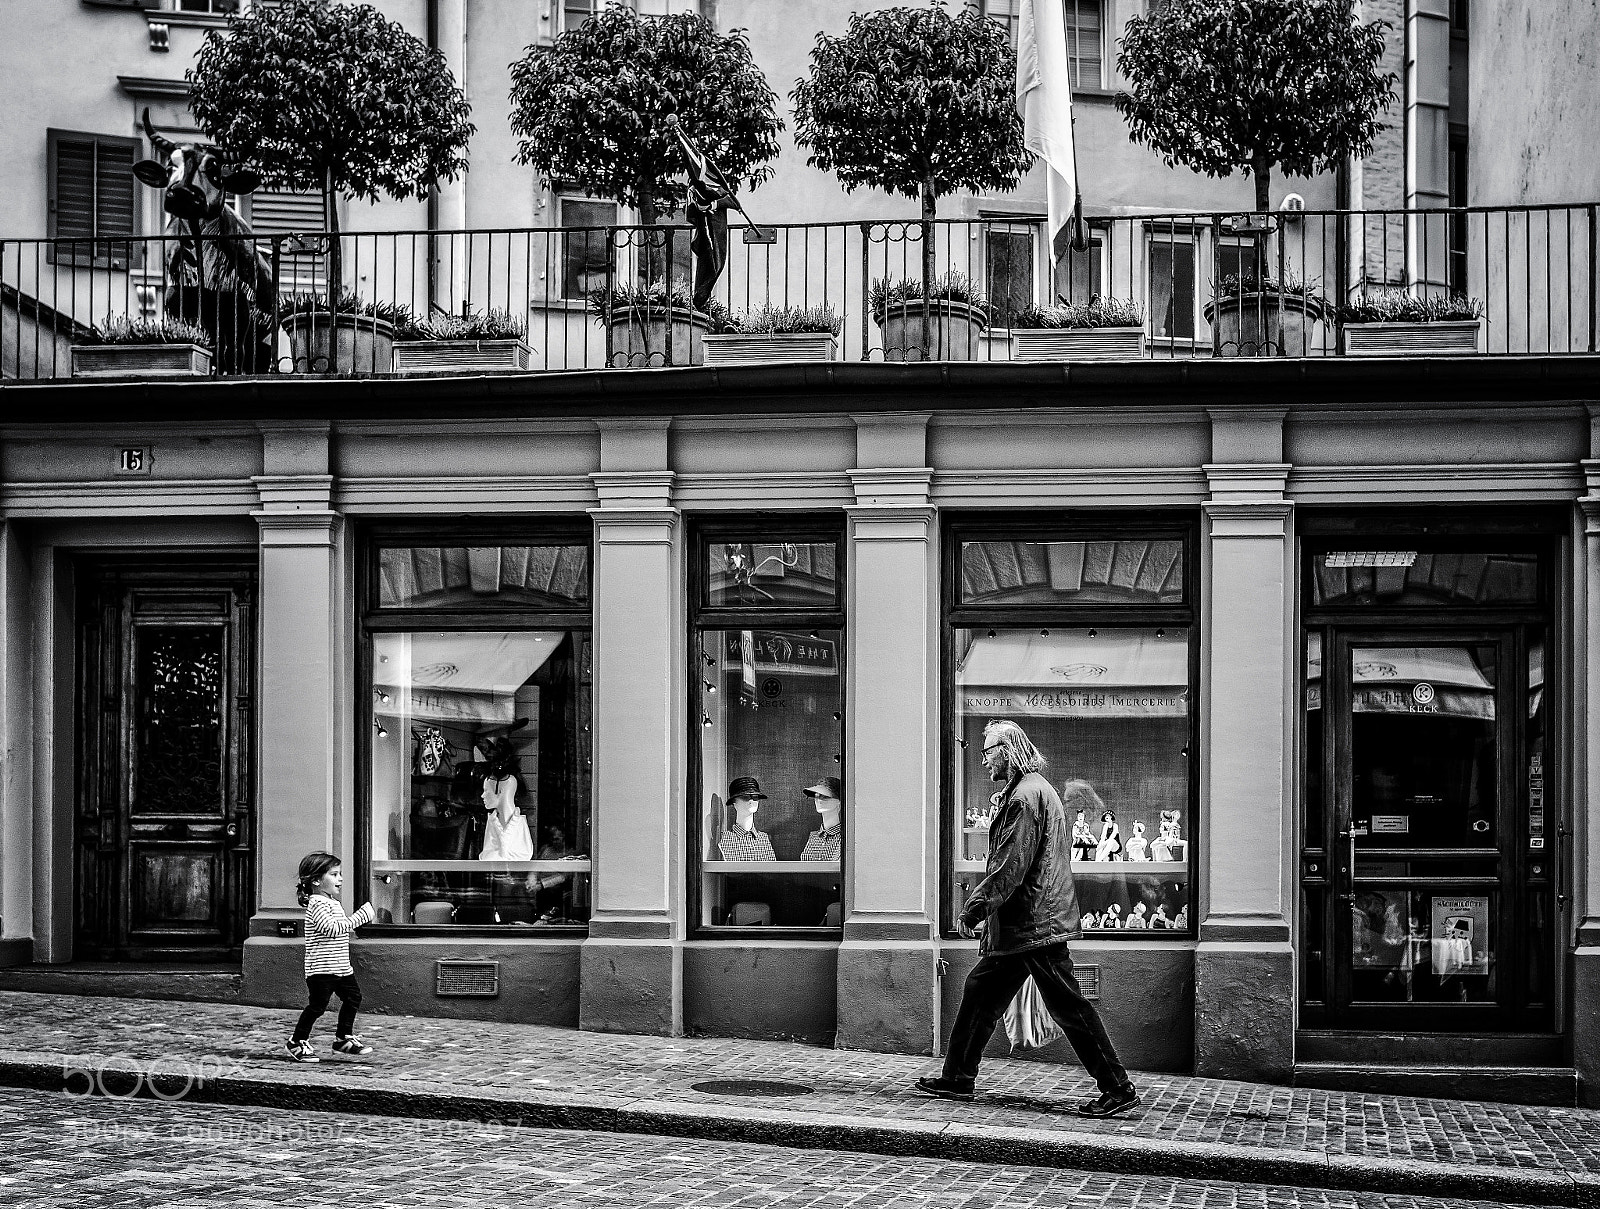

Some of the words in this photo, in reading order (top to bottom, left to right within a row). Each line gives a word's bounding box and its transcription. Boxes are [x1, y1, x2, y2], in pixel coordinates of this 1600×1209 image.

[122, 450, 142, 471] 15
[1115, 698, 1176, 707] MERCERIE
[1409, 705, 1438, 713] KECK
